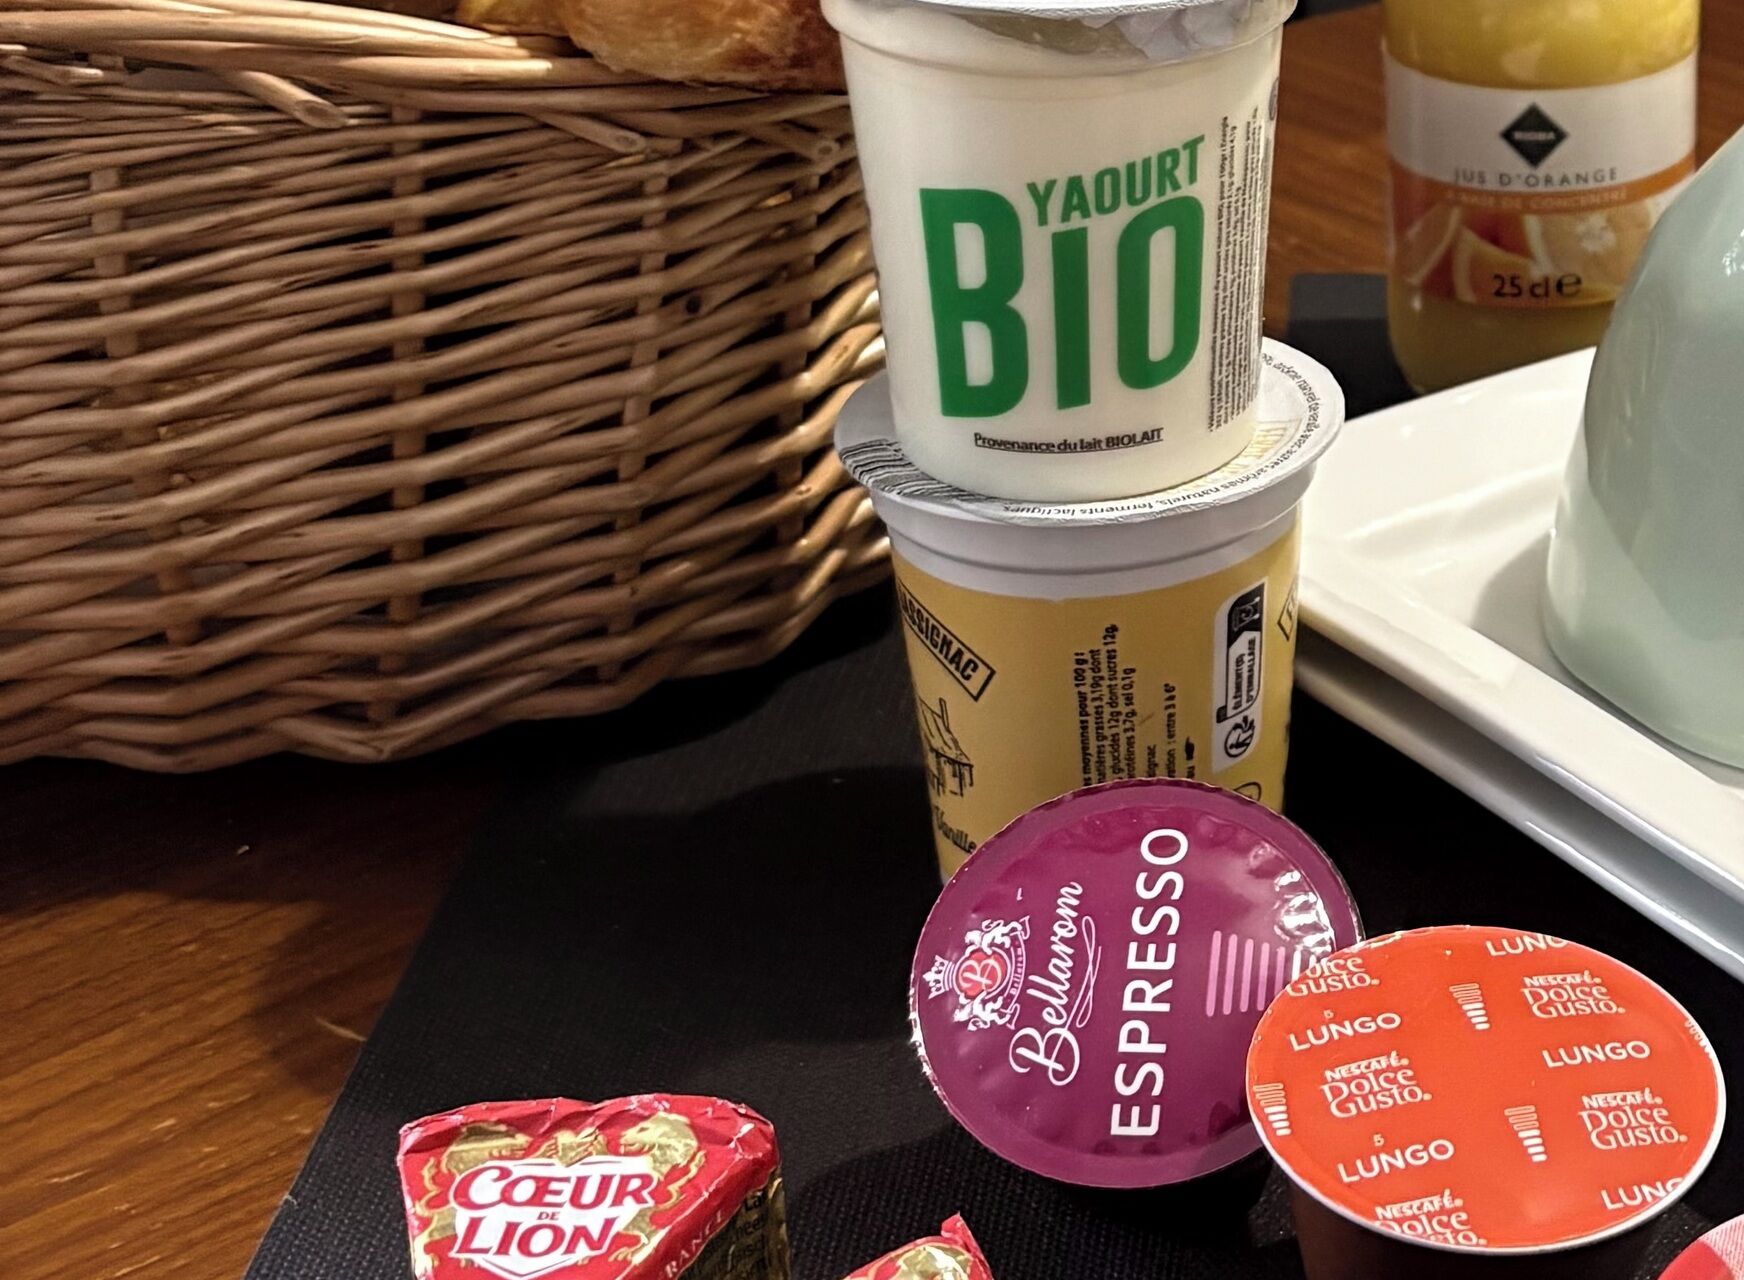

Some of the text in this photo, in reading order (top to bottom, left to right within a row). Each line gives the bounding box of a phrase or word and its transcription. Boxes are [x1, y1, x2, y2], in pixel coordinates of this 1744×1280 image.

[1026, 134, 1206, 228] YAOURT
[1454, 166, 1618, 189] JUS D'ORANGE
[1492, 272, 1550, 299] 25 cl
[919, 186, 1206, 419] BIO
[974, 427, 1164, 453] Provenance du lait BIOLAIT
[1088, 649, 1102, 674] dont
[1105, 648, 1118, 682] sucres
[1073, 667, 1086, 688] 100
[1076, 690, 1091, 717] pour
[1106, 683, 1119, 709] dont
[1121, 693, 1135, 707] sel
[1107, 710, 1123, 730] 12g
[1107, 732, 1125, 774] glucides
[1484, 933, 1568, 958] LUN
[1009, 881, 1086, 1086] Bellarom
[1110, 827, 1190, 1137] ESPRESSO
[1520, 983, 1611, 1009] Dolce
[1289, 1012, 1402, 1052] LUNGO
[1541, 1040, 1652, 1070] LUNGO
[1319, 1066, 1418, 1105] Dolce
[1577, 1104, 1672, 1134] Dolce
[1373, 1132, 1386, 1148] 5
[1336, 1138, 1455, 1184] LUNGO
[452, 1165, 657, 1212] CŒUR
[1601, 1176, 1684, 1212] LUN
[536, 1210, 561, 1222] DE
[455, 1216, 622, 1259] LION
